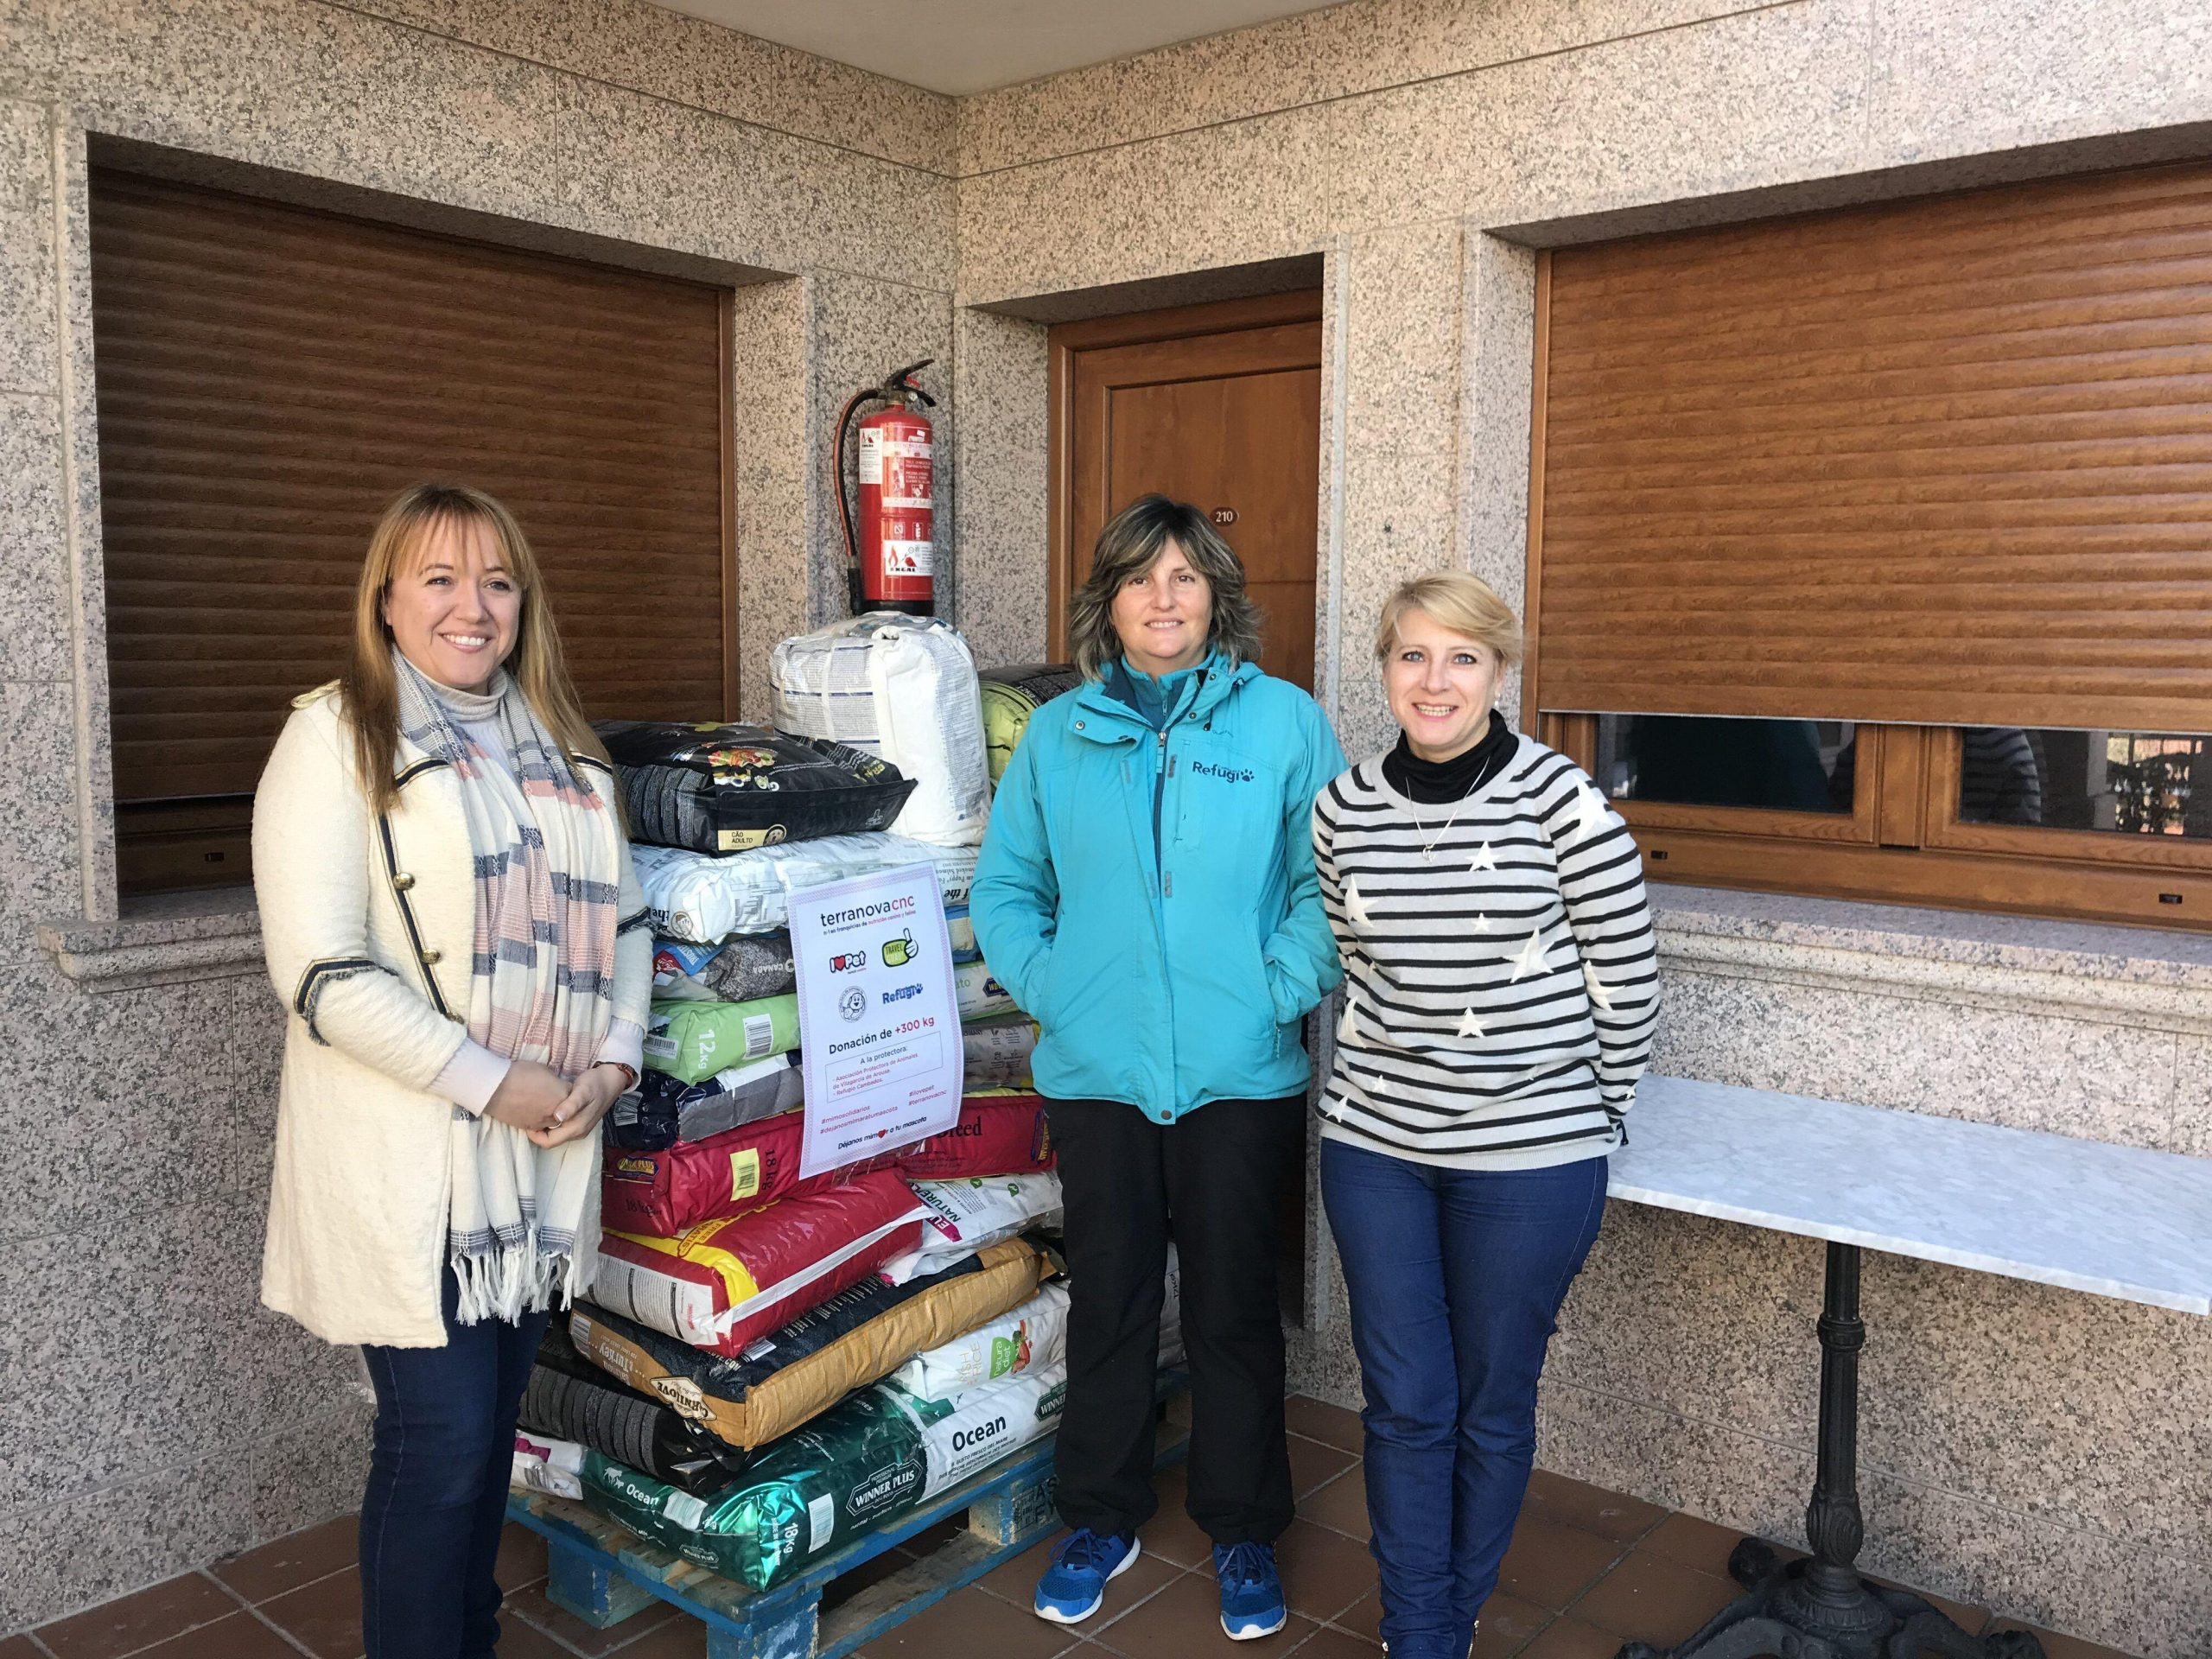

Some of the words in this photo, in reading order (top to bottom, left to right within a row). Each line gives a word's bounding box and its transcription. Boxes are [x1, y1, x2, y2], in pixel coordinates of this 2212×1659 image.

[1215, 511, 1233, 522] 210
[731, 836, 753, 845] ADULTO
[820, 895, 915, 927] terranovacnc
[753, 963, 783, 974] CANADA
[829, 1033, 878, 1054] Donación
[880, 1028, 893, 1039] de
[894, 1019, 920, 1034] +300
[922, 1016, 935, 1027] kg
[863, 1061, 889, 1073] Protectora
[836, 1085, 856, 1096] Refugio
[909, 1084, 935, 1097] #ilovepet
[821, 1104, 871, 1124] #mimosolidarios
[838, 1135, 863, 1150] Déjanos
[902, 1116, 927, 1129] mascota
[766, 1148, 777, 1166] 18
[761, 1169, 777, 1191] kg
[994, 1340, 1002, 1376] natura
[952, 1415, 1007, 1452] Ocean
[626, 1483, 658, 1506] Ocean
[855, 1480, 892, 1509] WINNER
[892, 1470, 916, 1492] PLUS
